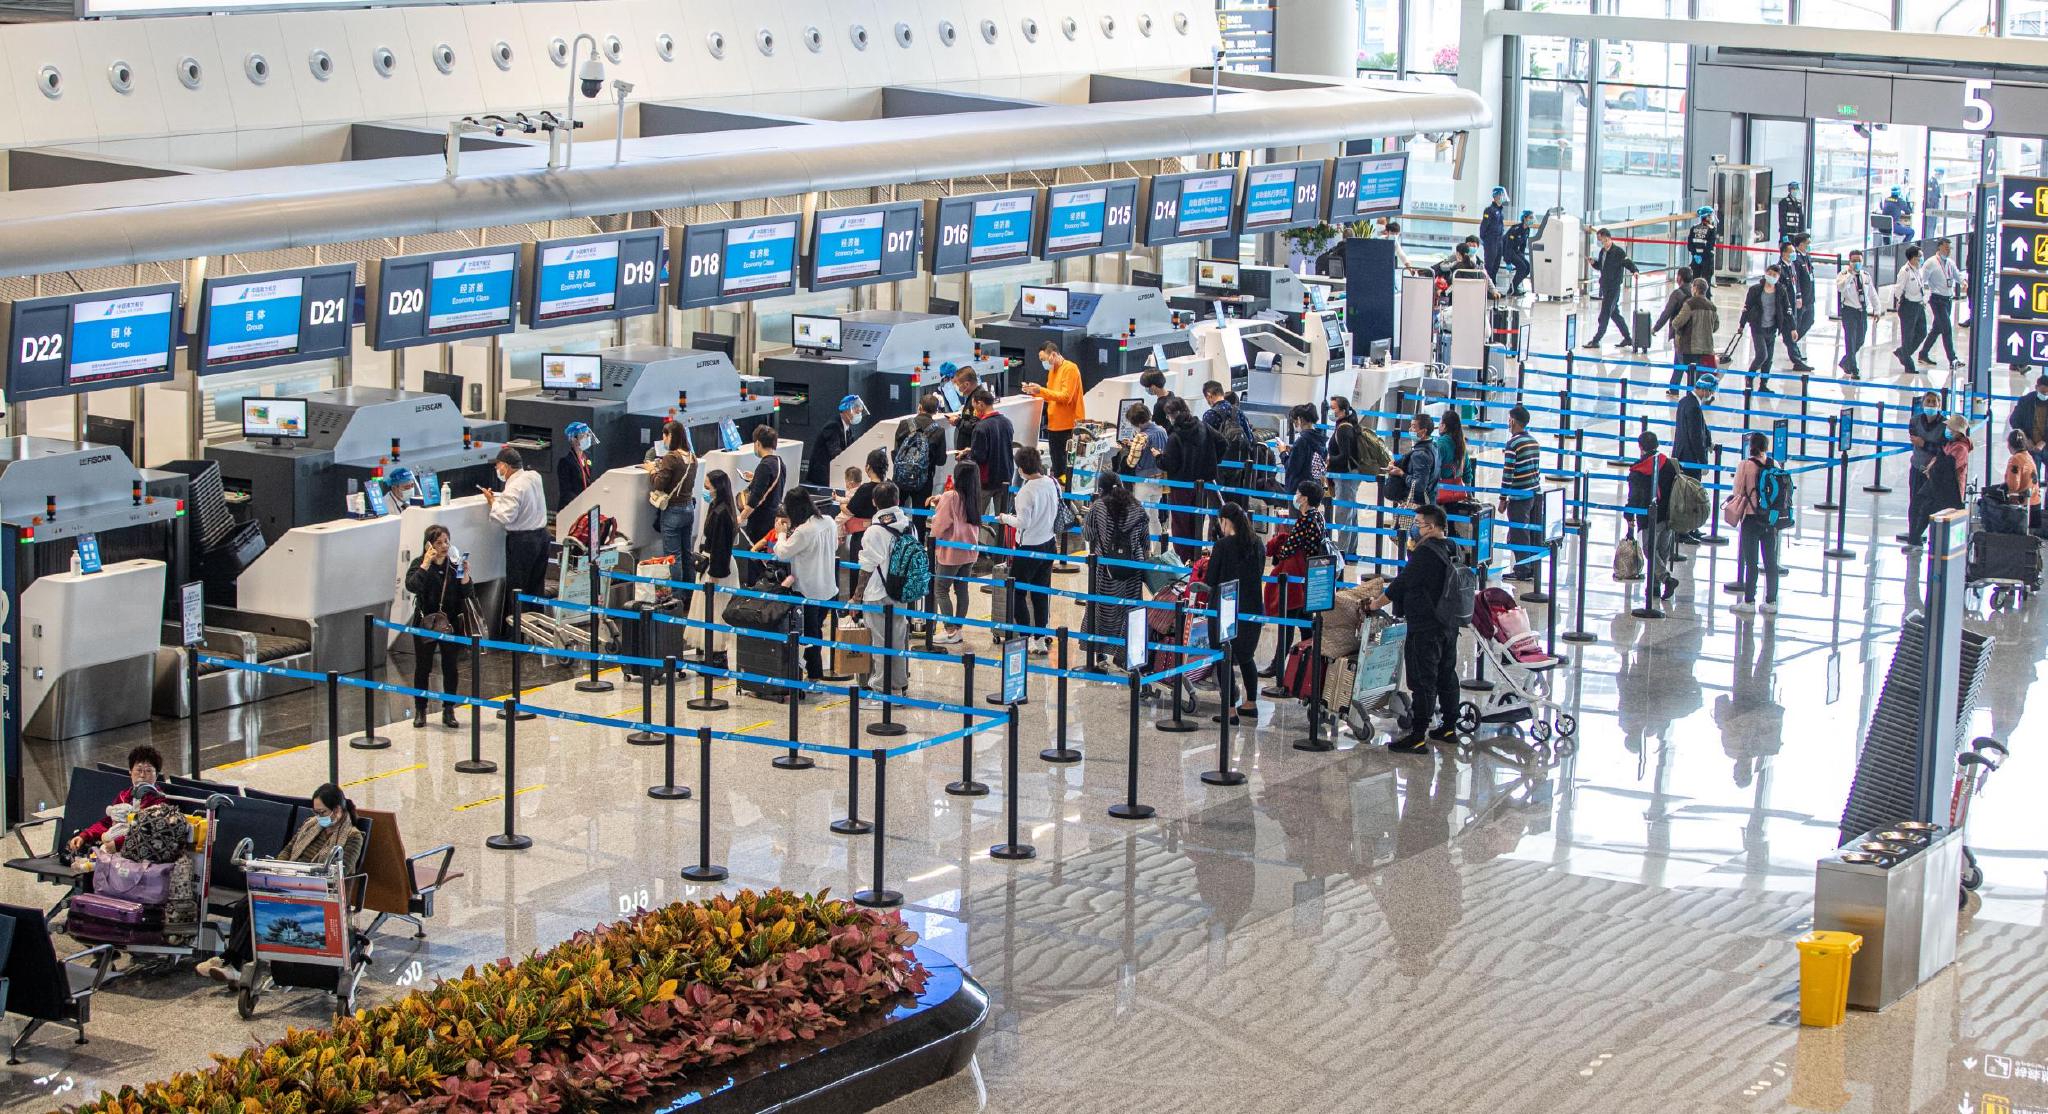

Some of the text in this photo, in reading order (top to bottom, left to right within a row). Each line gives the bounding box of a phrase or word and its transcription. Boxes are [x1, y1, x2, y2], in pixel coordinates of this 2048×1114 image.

[1962, 79, 1993, 130] 5
[1987, 148, 1995, 175] 2
[1297, 184, 1318, 203] D13
[1338, 180, 1357, 199] D12
[1108, 206, 1131, 225] D15
[1155, 200, 1177, 220] D14
[888, 230, 914, 253] D17
[943, 223, 968, 245] D16
[624, 261, 655, 285] D19
[690, 253, 720, 278] D18
[310, 298, 344, 326] D21
[389, 289, 423, 315] D20
[246, 324, 264, 332] Group
[21, 333, 63, 363] D22
[112, 340, 131, 349] Group
